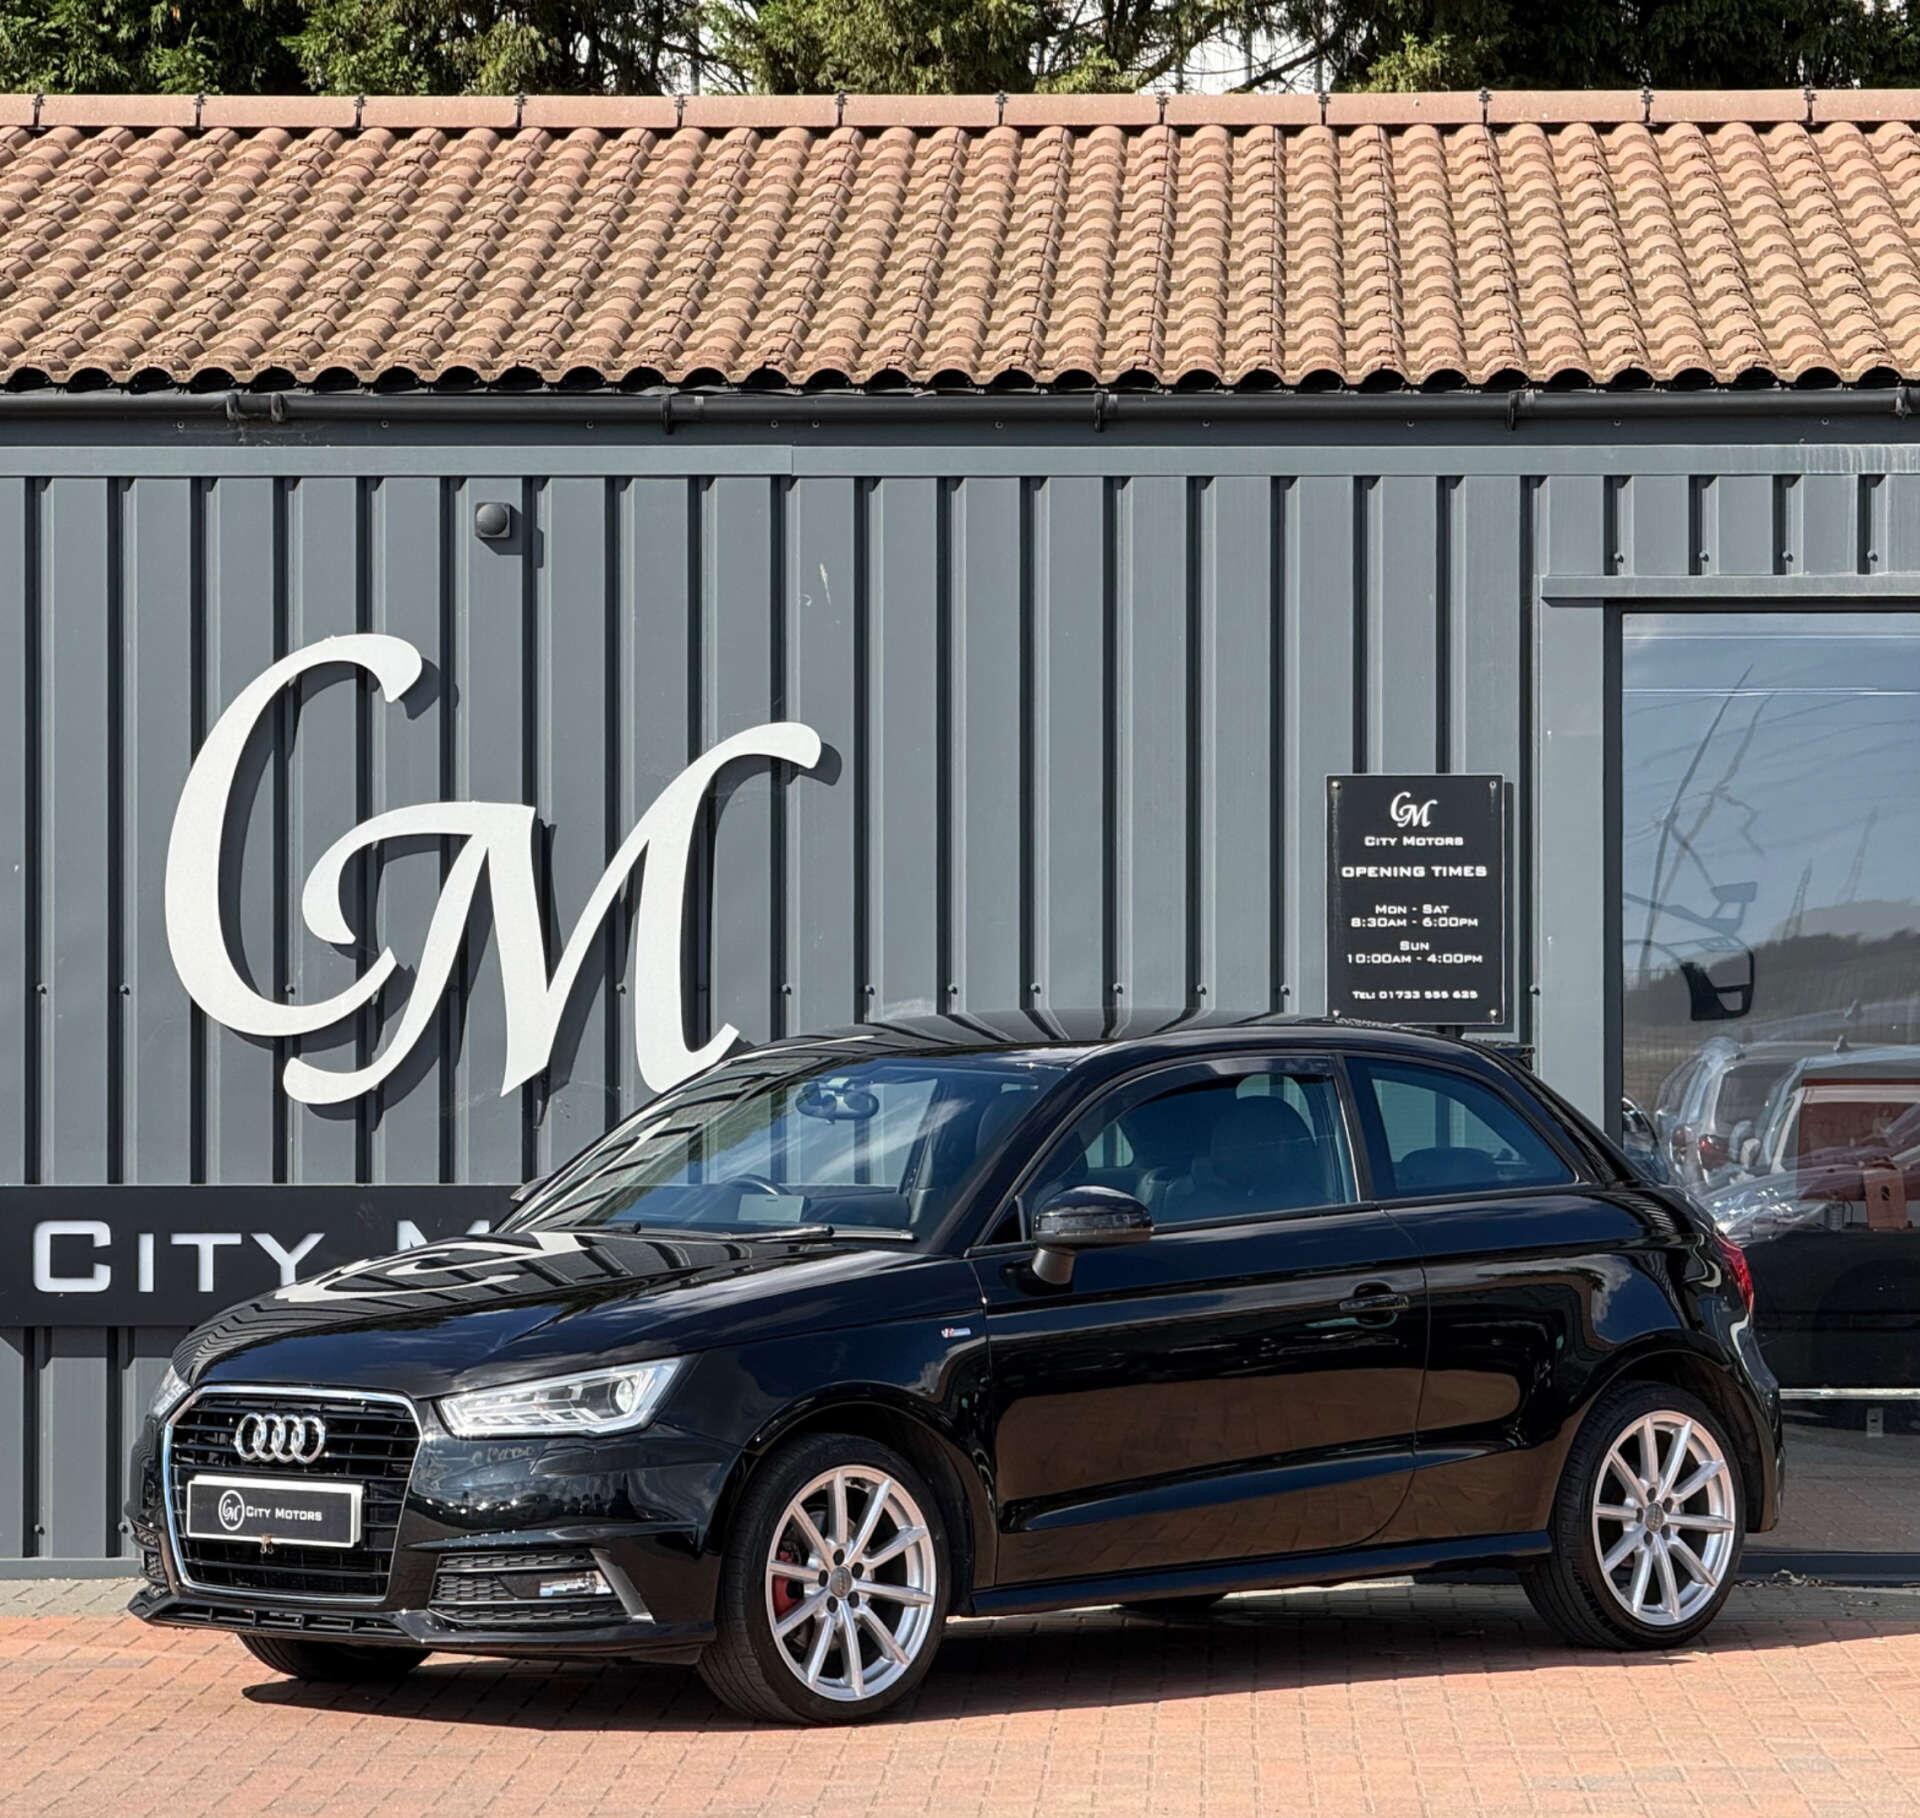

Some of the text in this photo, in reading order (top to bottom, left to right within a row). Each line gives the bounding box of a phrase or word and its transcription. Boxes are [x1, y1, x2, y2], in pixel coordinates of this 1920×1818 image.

[1364, 836, 1464, 846] CITY MOTORS
[1341, 866, 1487, 878] OPENING TIMES
[1375, 904, 1407, 914] MON
[1422, 904, 1449, 914] SAT
[1400, 940, 1430, 951] SUN
[1379, 990, 1420, 999] 01733
[33, 1220, 325, 1293] CITY
[246, 1506, 322, 1521] CITY MOTORS
